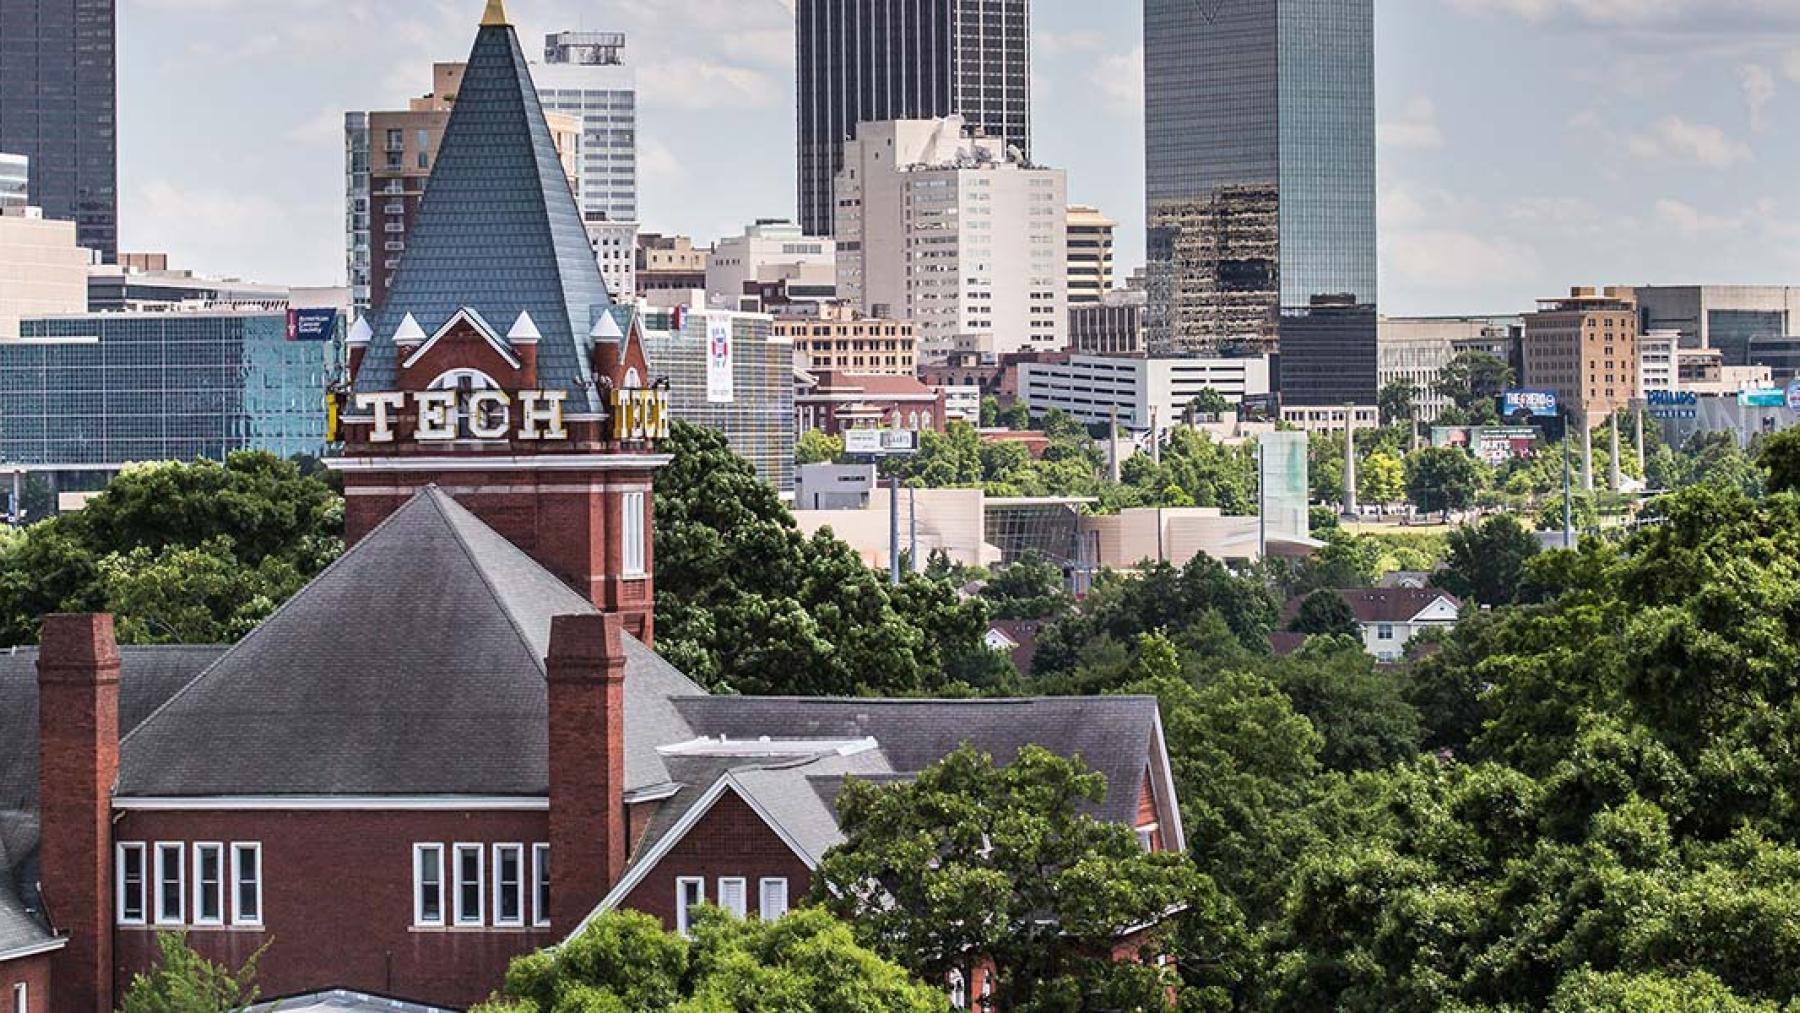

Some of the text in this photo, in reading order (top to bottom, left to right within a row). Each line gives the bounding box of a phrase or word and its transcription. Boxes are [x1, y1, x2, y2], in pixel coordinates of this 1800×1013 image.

[355, 390, 568, 442] TECH
[614, 390, 670, 438] TECH
[1647, 390, 1696, 405] PHILIPS
